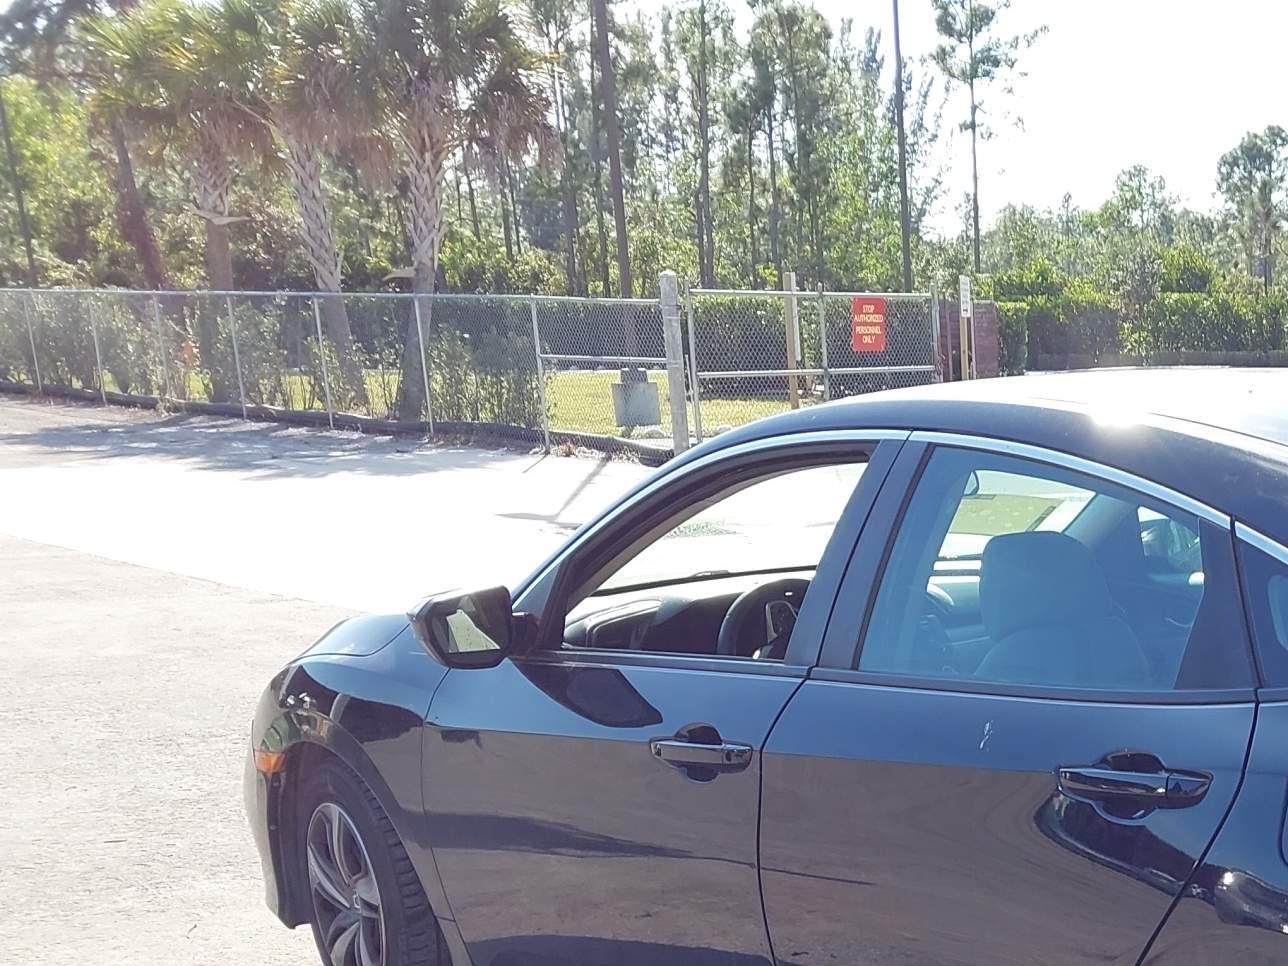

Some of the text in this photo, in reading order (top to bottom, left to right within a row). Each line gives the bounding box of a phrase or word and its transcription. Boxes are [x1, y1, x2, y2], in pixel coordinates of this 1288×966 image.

[862, 304, 875, 313] STOP
[854, 314, 884, 323] AUTHORIZED
[855, 326, 882, 335] PERSONNEL
[862, 335, 876, 344] ONLY
